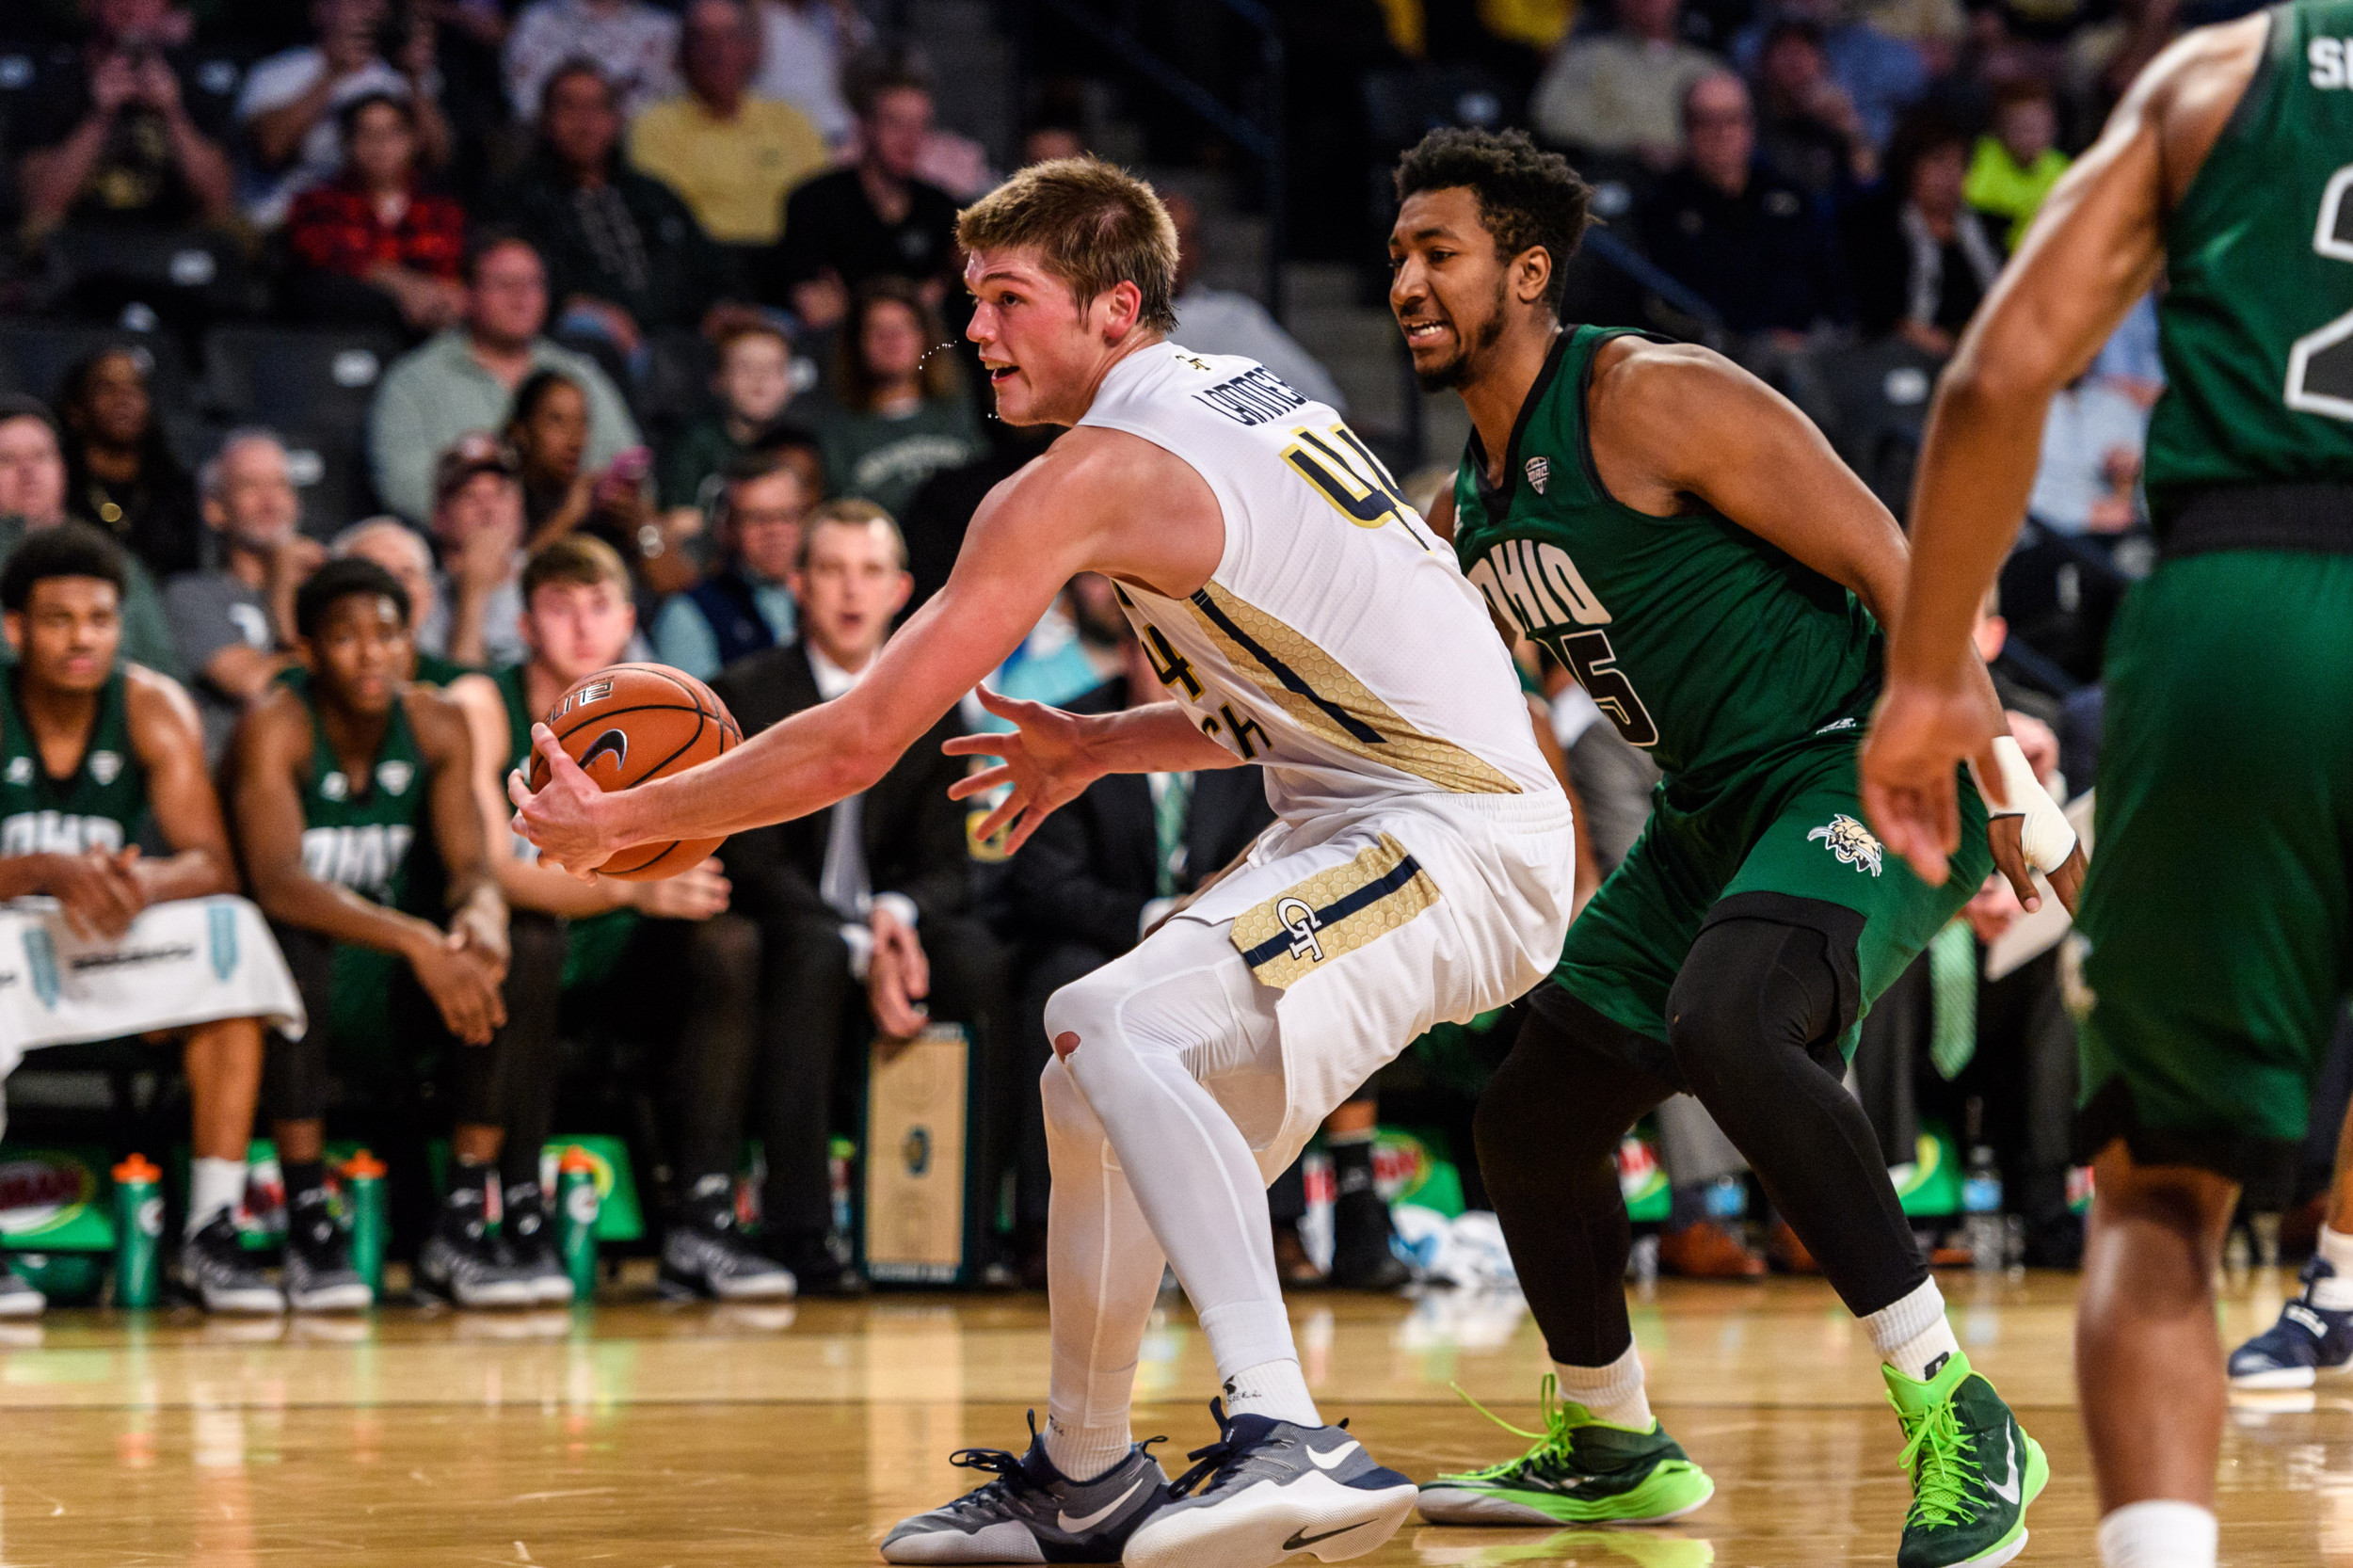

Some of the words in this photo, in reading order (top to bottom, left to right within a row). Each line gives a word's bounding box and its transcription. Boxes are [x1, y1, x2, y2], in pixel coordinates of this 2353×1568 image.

[2307, 36, 2353, 92] S
[1190, 364, 1311, 426] LAMMER
[1467, 539, 1612, 634] OHIO
[1558, 629, 1659, 747] 5
[1276, 896, 1325, 963] GT
